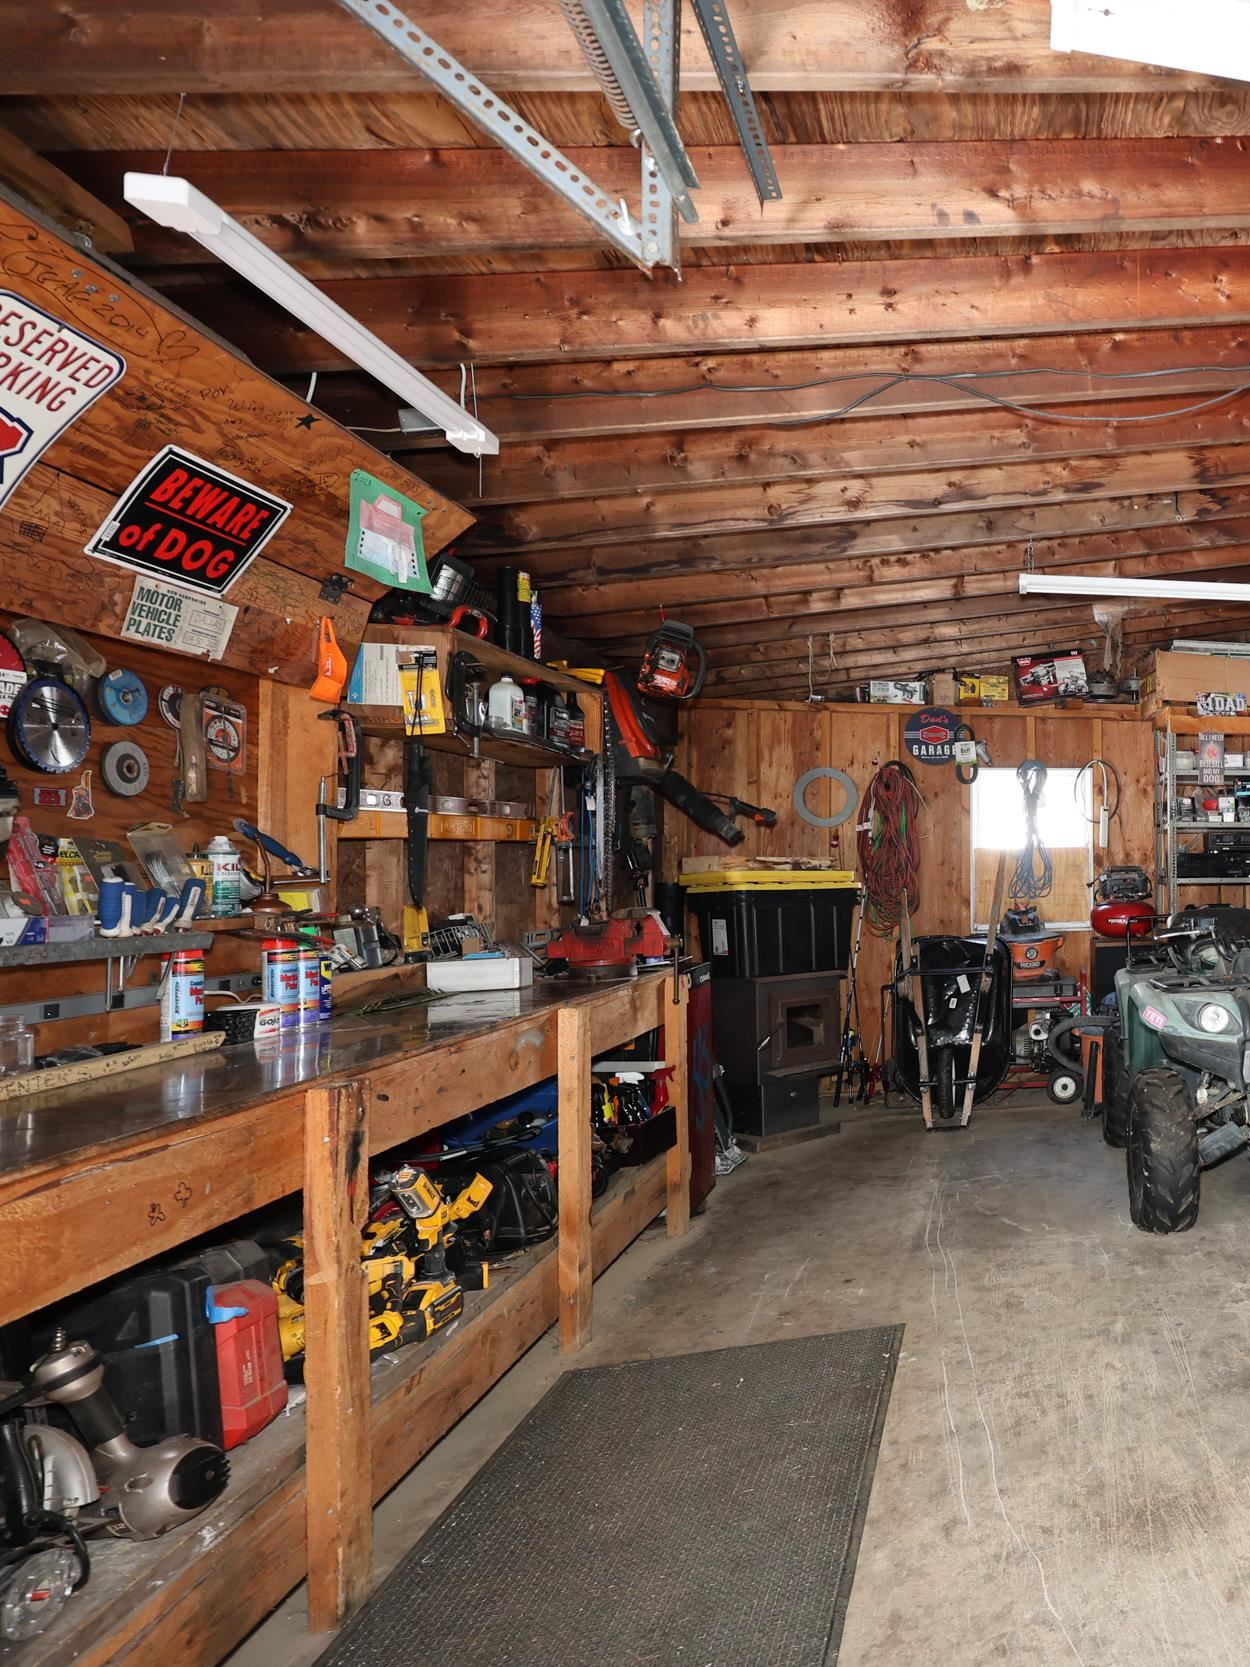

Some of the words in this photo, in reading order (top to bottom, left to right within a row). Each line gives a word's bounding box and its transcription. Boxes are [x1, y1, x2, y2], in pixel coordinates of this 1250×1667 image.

[0, 304, 114, 389] ESERVED
[150, 468, 270, 540] BEWARE
[118, 523, 163, 551] of
[153, 528, 235, 579] DOG
[136, 587, 183, 612] MOTOR
[131, 601, 182, 628] VEHICLE
[126, 617, 175, 643] PLATES
[0, 682, 22, 696] ADE
[1216, 697, 1246, 712] DAD
[1200, 759, 1224, 768] BASEBALL
[1203, 775, 1220, 784] DOG
[1145, 1007, 1165, 1027] YETI
